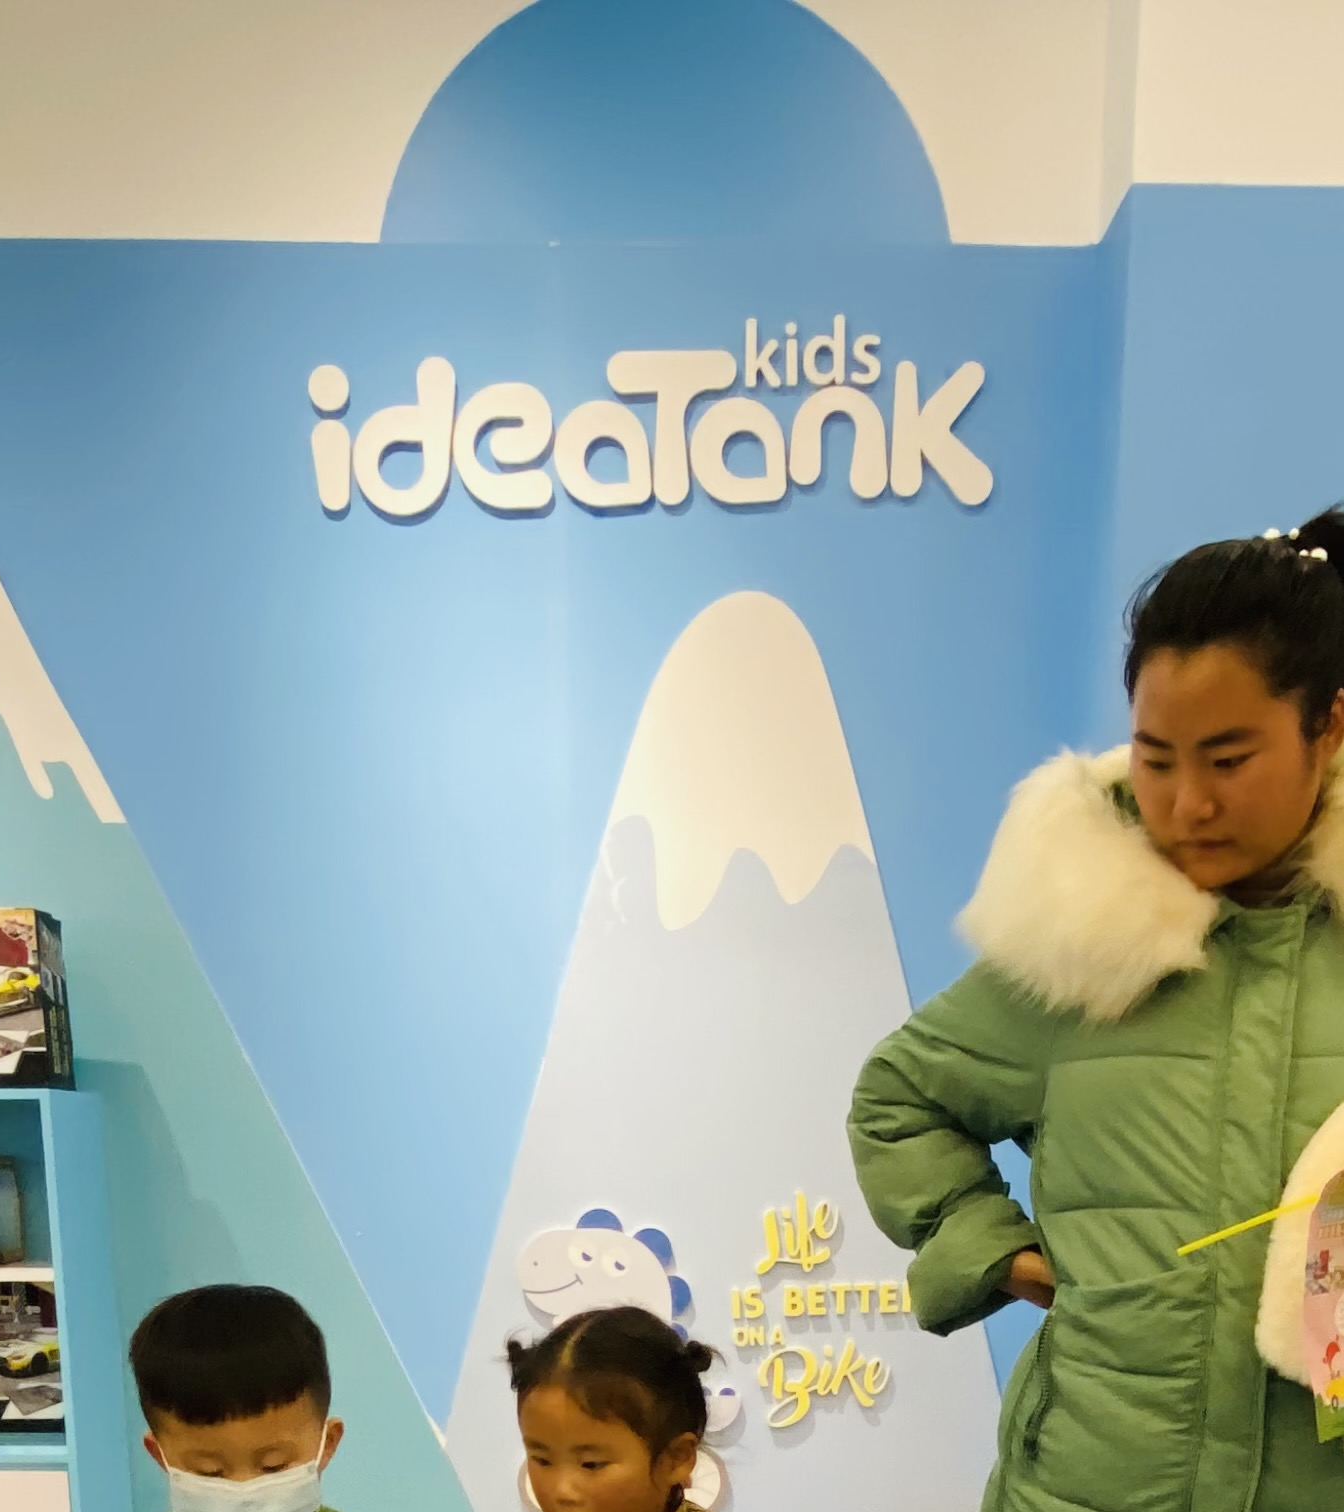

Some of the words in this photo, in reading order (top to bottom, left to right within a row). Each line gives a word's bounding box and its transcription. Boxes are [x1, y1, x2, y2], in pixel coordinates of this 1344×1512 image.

[744, 314, 882, 388] kids
[756, 1190, 841, 1276] Life
[731, 1285, 765, 1320] IS
[784, 1281, 912, 1318] BETTE
[731, 1327, 765, 1348] ON
[769, 1327, 786, 1347] A
[757, 1339, 892, 1429] Bike
